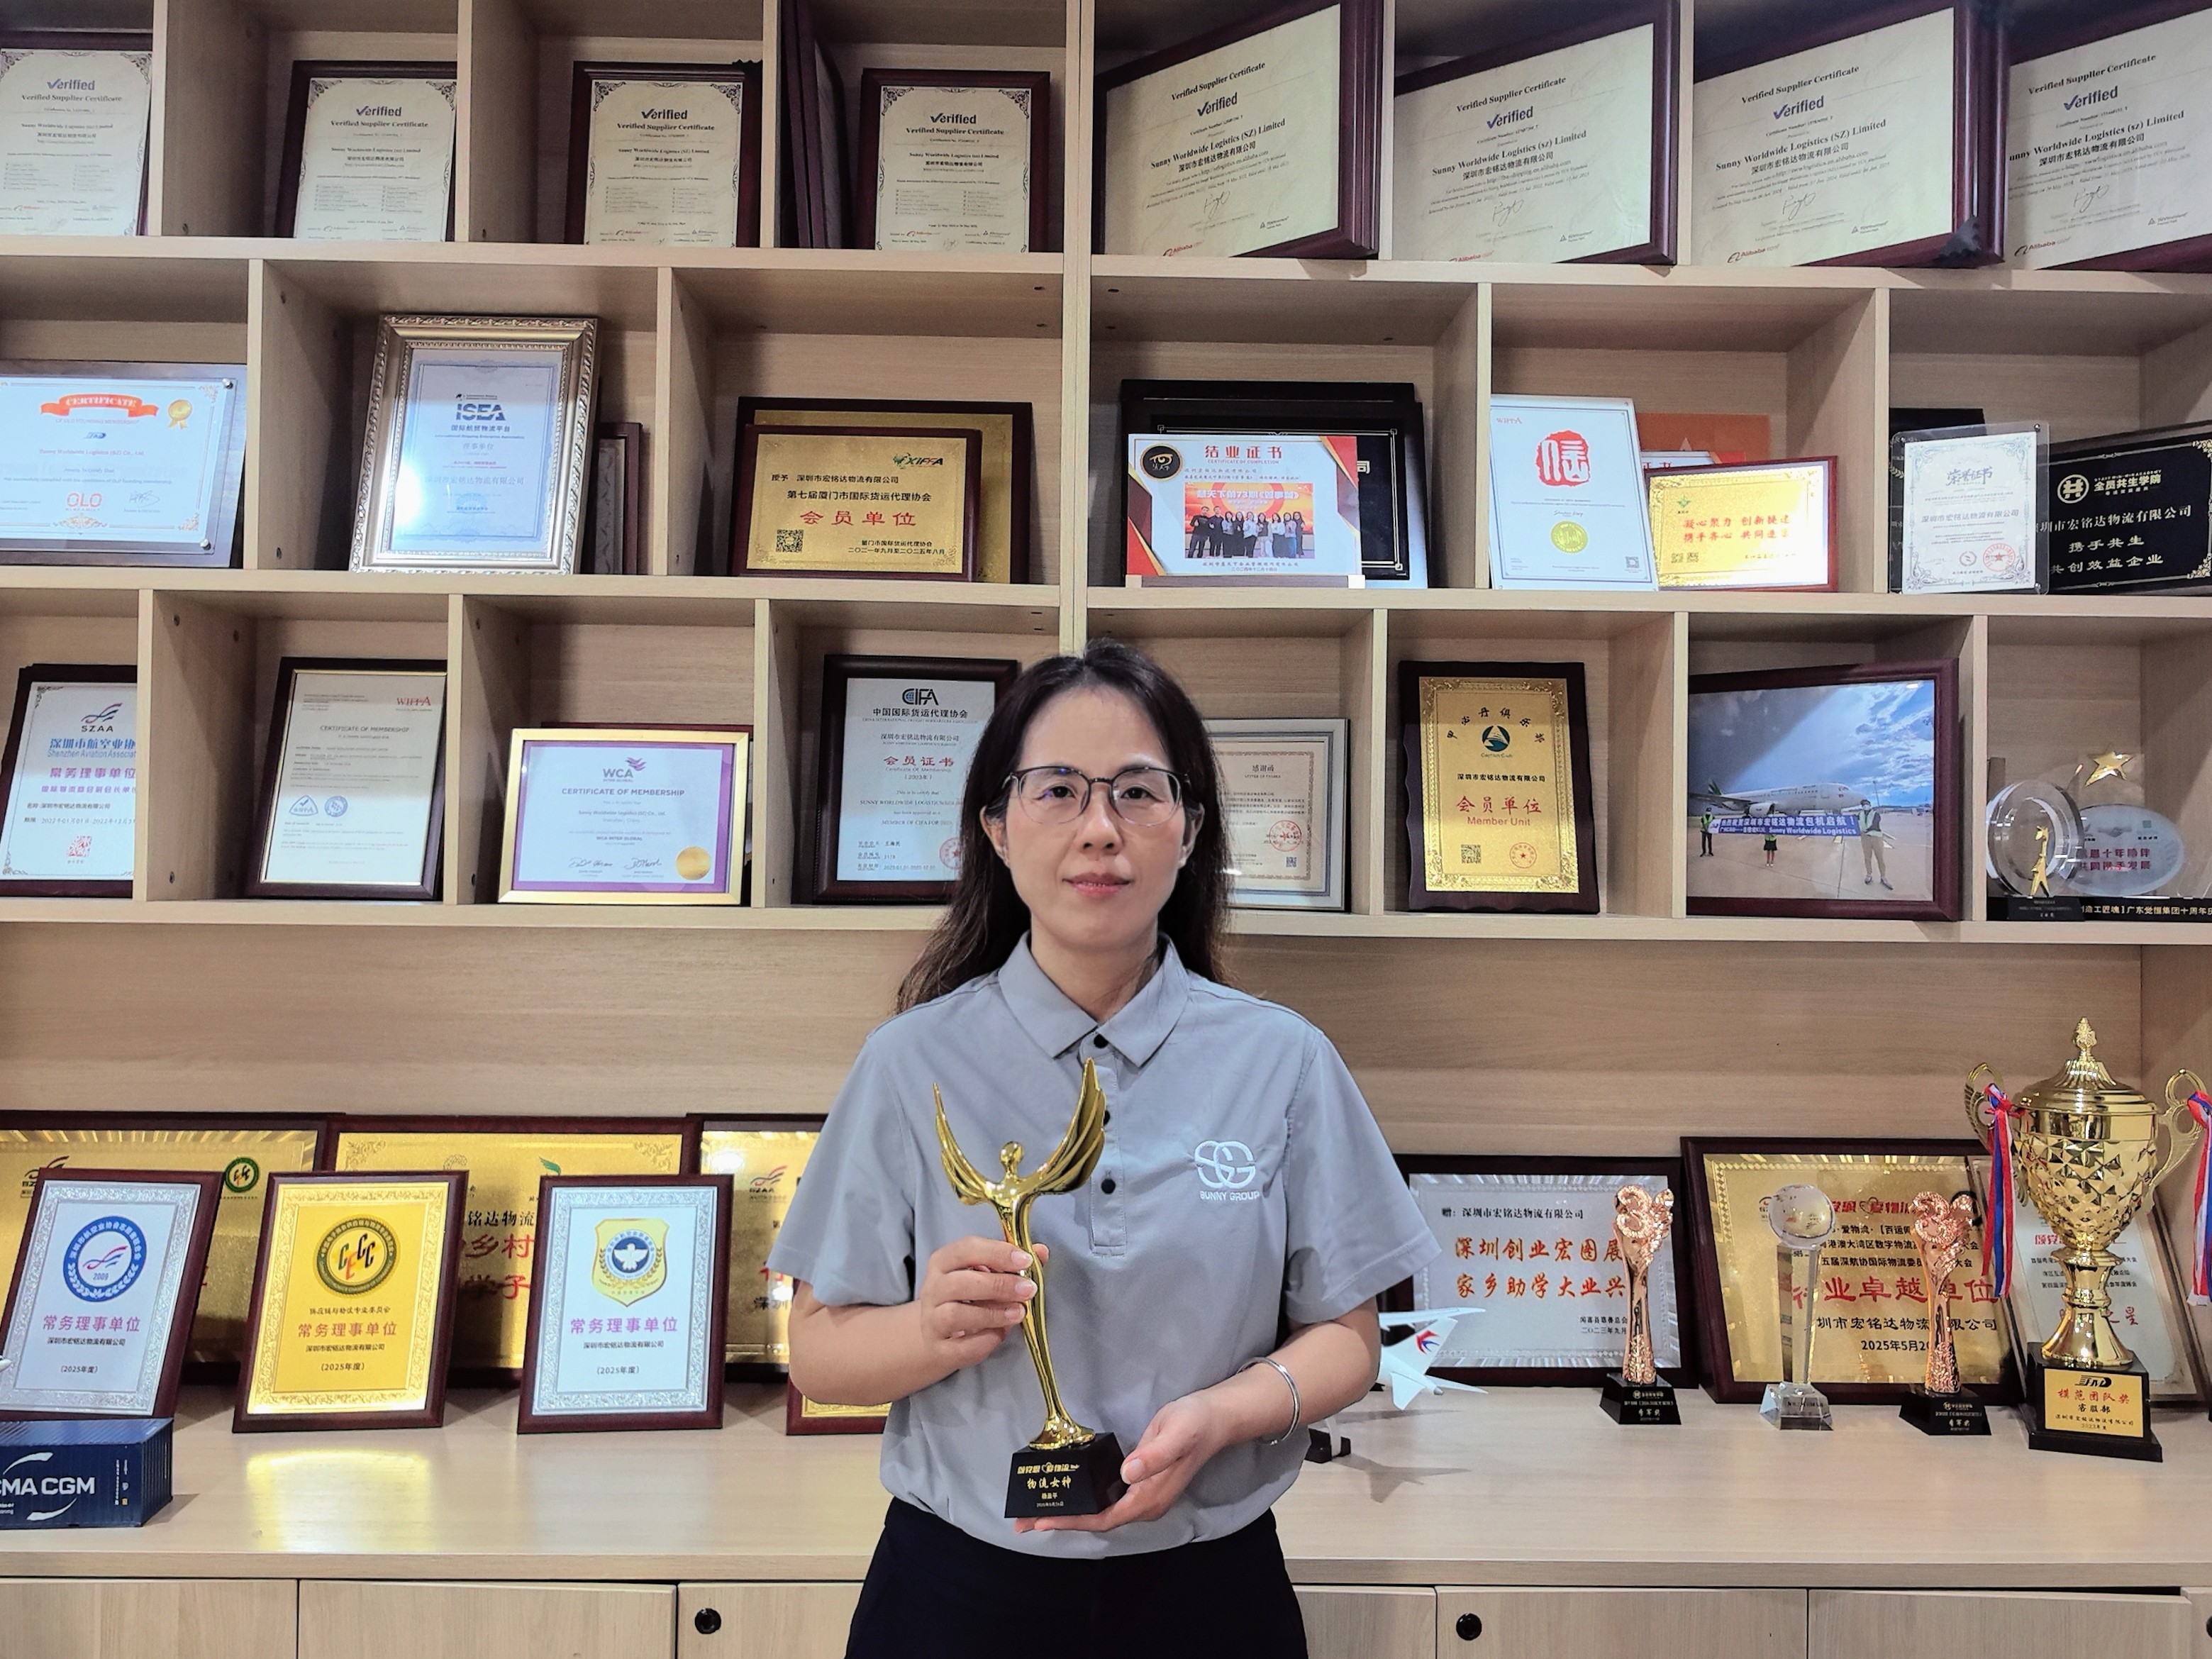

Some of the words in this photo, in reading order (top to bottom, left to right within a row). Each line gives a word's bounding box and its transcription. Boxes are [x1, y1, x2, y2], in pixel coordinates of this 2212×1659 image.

[1171, 85, 1199, 101] Verified
[1199, 76, 1228, 91] Supplier
[1229, 62, 1266, 81] Certificate
[2029, 79, 2064, 94] Verified
[2067, 69, 2106, 85] Supplier
[2107, 55, 2156, 72] Certificate
[48, 79, 95, 90] Verified
[1742, 89, 1774, 104] Verified
[1776, 78, 1812, 94] Supplier
[1814, 66, 1860, 83] Certificate
[1457, 96, 1487, 112] Verified
[1489, 89, 1522, 104] Supplier
[1524, 77, 1567, 94] Certificate
[2064, 86, 2118, 110] Verified
[356, 106, 402, 116] Verified
[1197, 91, 1238, 117] Verified
[1773, 96, 1824, 119] Verified
[641, 109, 688, 119] Verified
[930, 113, 977, 124] Verified
[1486, 106, 1533, 128] Verified
[1150, 155, 1172, 170] Sunny
[1172, 143, 1209, 163] Worldwide
[1210, 134, 1240, 155] Logistics
[1258, 118, 1286, 135] Limited
[2009, 150, 2030, 162] unny
[2034, 138, 2082, 155] Worldwide
[2085, 126, 2125, 143] Logistics
[2147, 111, 2184, 127] Limited
[1716, 159, 1741, 171] Sunny
[1745, 146, 1788, 163] Worldwide
[1791, 136, 1828, 153] Logistics
[1830, 131, 1850, 143] (SZ)
[1853, 119, 1886, 135] Limited
[1432, 164, 1455, 176] Sunny
[1458, 152, 1500, 170] Worldwide
[1502, 143, 1537, 160] Logistics
[1555, 131, 1587, 145] Limited
[65, 396, 137, 407] CERTIFICATE
[456, 403, 506, 421] ISEA
[1205, 445, 1282, 459] 结业证书
[771, 474, 789, 482] 授予
[796, 475, 899, 484] 深圳市宏铭达物流有限公司
[2094, 475, 2162, 492] 全员共生学院
[787, 490, 932, 502] 第七届厦门市国际货运代理协会
[800, 510, 917, 526] 会员单位
[2037, 505, 2191, 533] 圳市宏铭达物流有限公司
[2068, 536, 2145, 553] 携手共生
[2050, 554, 2163, 575] 共创效益企业
[902, 688, 939, 706] CIFA
[873, 708, 968, 718] 中国国际货运代理协会
[48, 750, 80, 758] Shenzhen
[81, 750, 106, 758] Aviation
[884, 756, 955, 767] 会员证书
[50, 767, 135, 778] 常务理事单位
[603, 769, 633, 778] WCA
[1457, 773, 1545, 782] 深圳市宏铭达物流有限公司
[1456, 795, 1542, 815] 会员单位
[1467, 817, 1508, 826] Member
[1511, 818, 1530, 826] Unit
[2078, 848, 2150, 858] 恩十年陪伴
[1200, 1191, 1226, 1201] SUNNY
[1229, 1191, 1260, 1201] GROUP
[468, 1210, 535, 1226] 铭达物流
[1462, 1207, 1584, 1219] 深圳市宏铭达物流有限公司
[1454, 1236, 1623, 1262] 深圳创业宏图展
[1821, 1240, 1918, 1250] 港澳大湾区数字物流
[1955, 1258, 1972, 1267] 大会
[1457, 1272, 1626, 1299] 家乡助学大业兴
[43, 1315, 140, 1332] 常务理事单位
[299, 1322, 397, 1338] 常务理事单位
[570, 1317, 678, 1333] 常务理事单位
[1817, 1317, 1997, 1331] 圳市宏铭达物流限公司
[321, 1363, 366, 1371] （2025年度）
[597, 1366, 641, 1375] （2025年度）
[2057, 1388, 2130, 1404] 模范团队奖
[2079, 1403, 2111, 1414] 客服部
[41, 1477, 95, 1495] CGM
[1027, 1475, 1072, 1489] 物流女神
